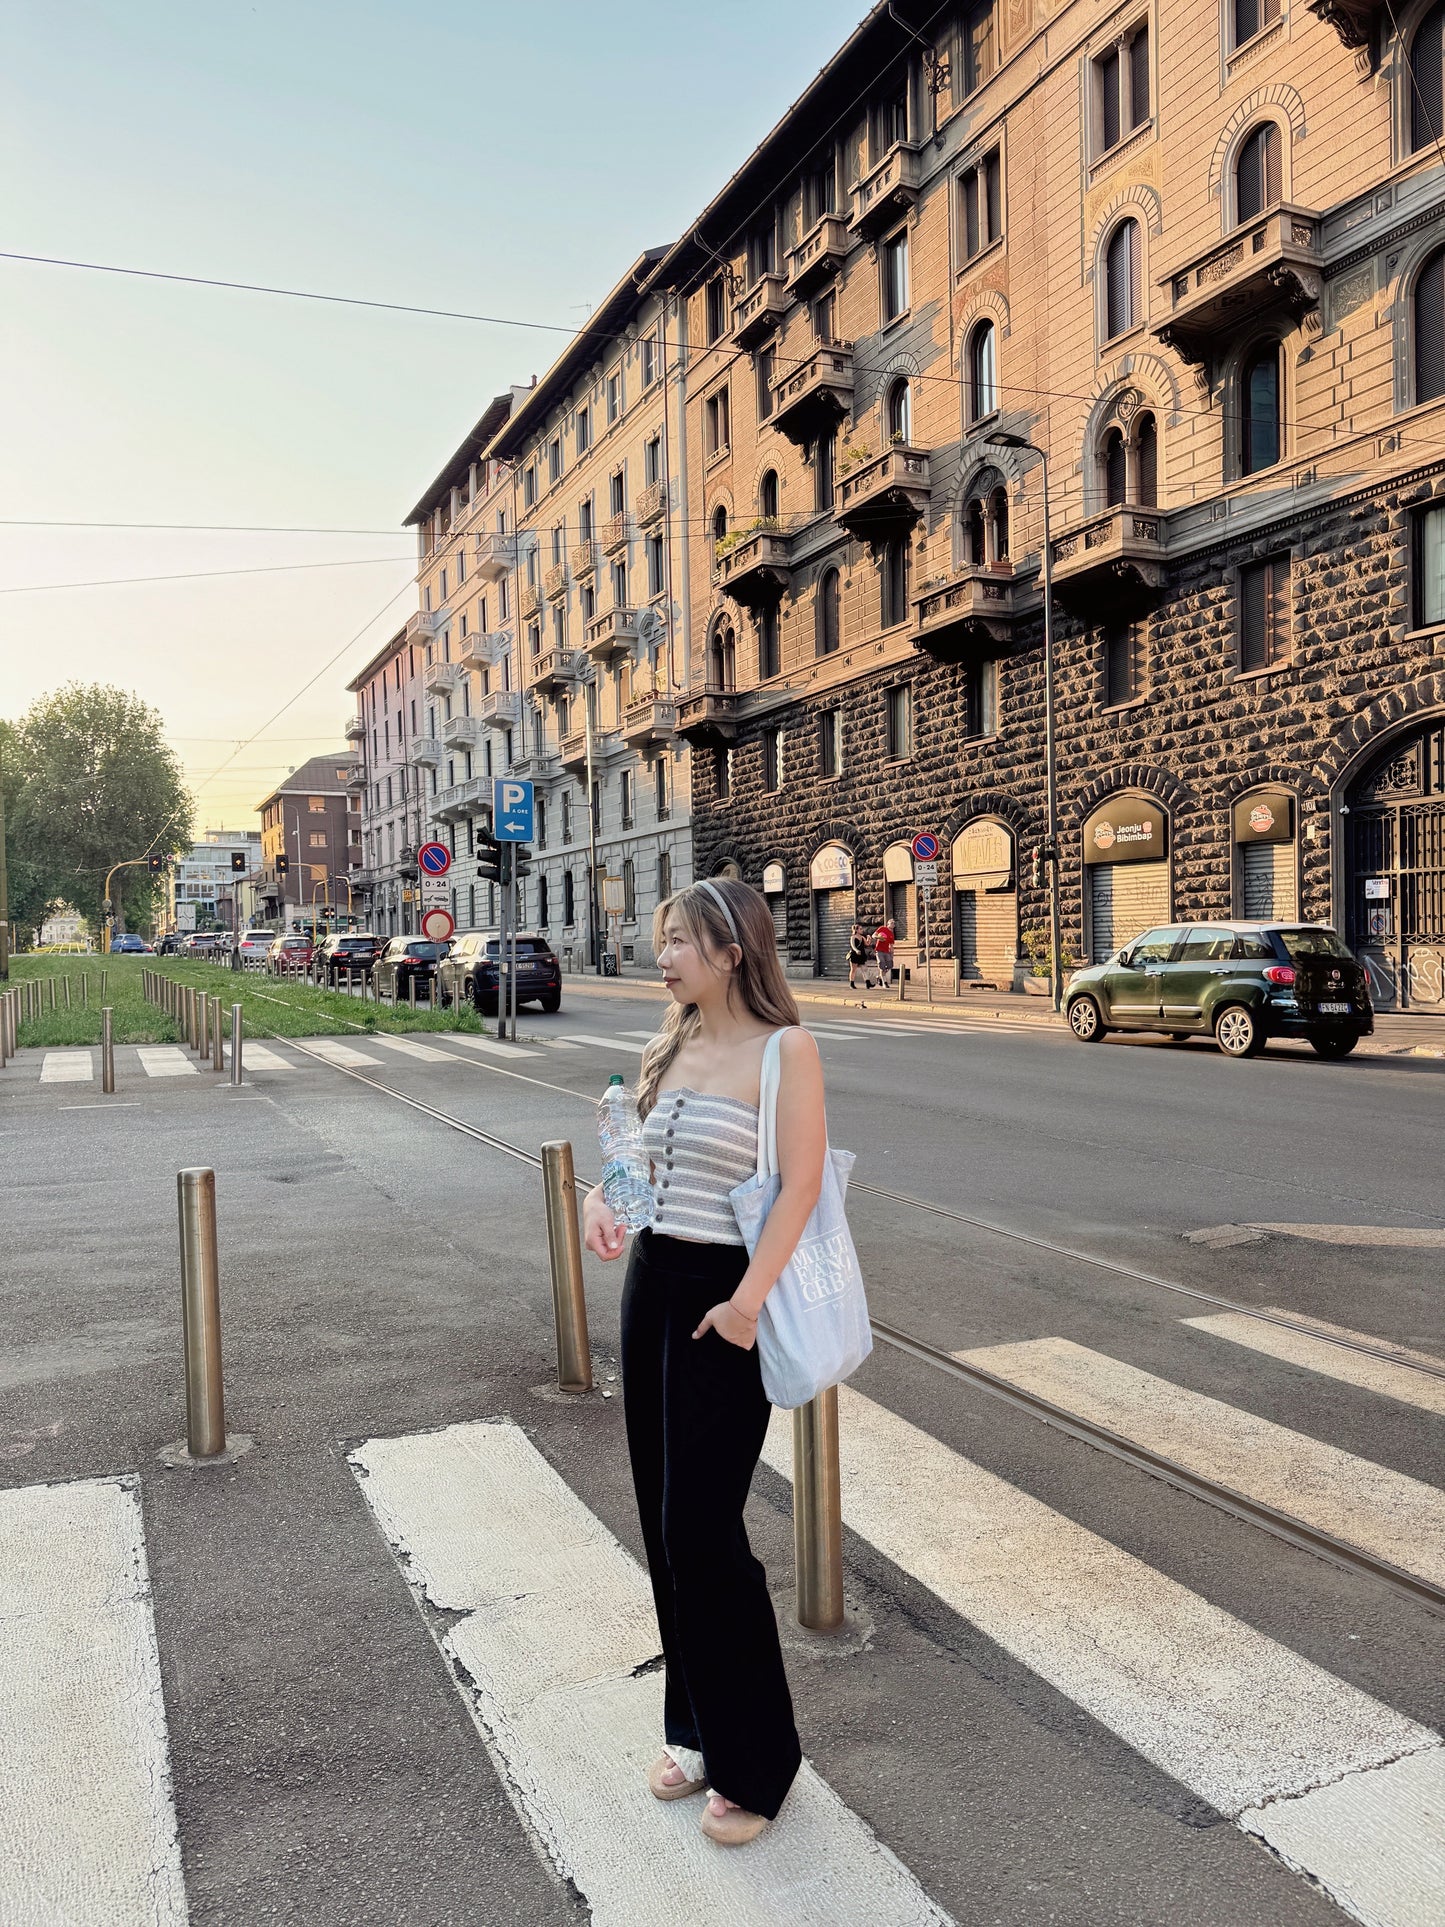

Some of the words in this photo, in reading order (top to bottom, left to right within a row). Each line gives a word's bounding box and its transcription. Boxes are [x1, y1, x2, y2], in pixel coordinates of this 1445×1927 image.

[503, 784, 525, 812] P
[1117, 824, 1142, 833] Jeonju
[1117, 832, 1152, 843] Bibimbap
